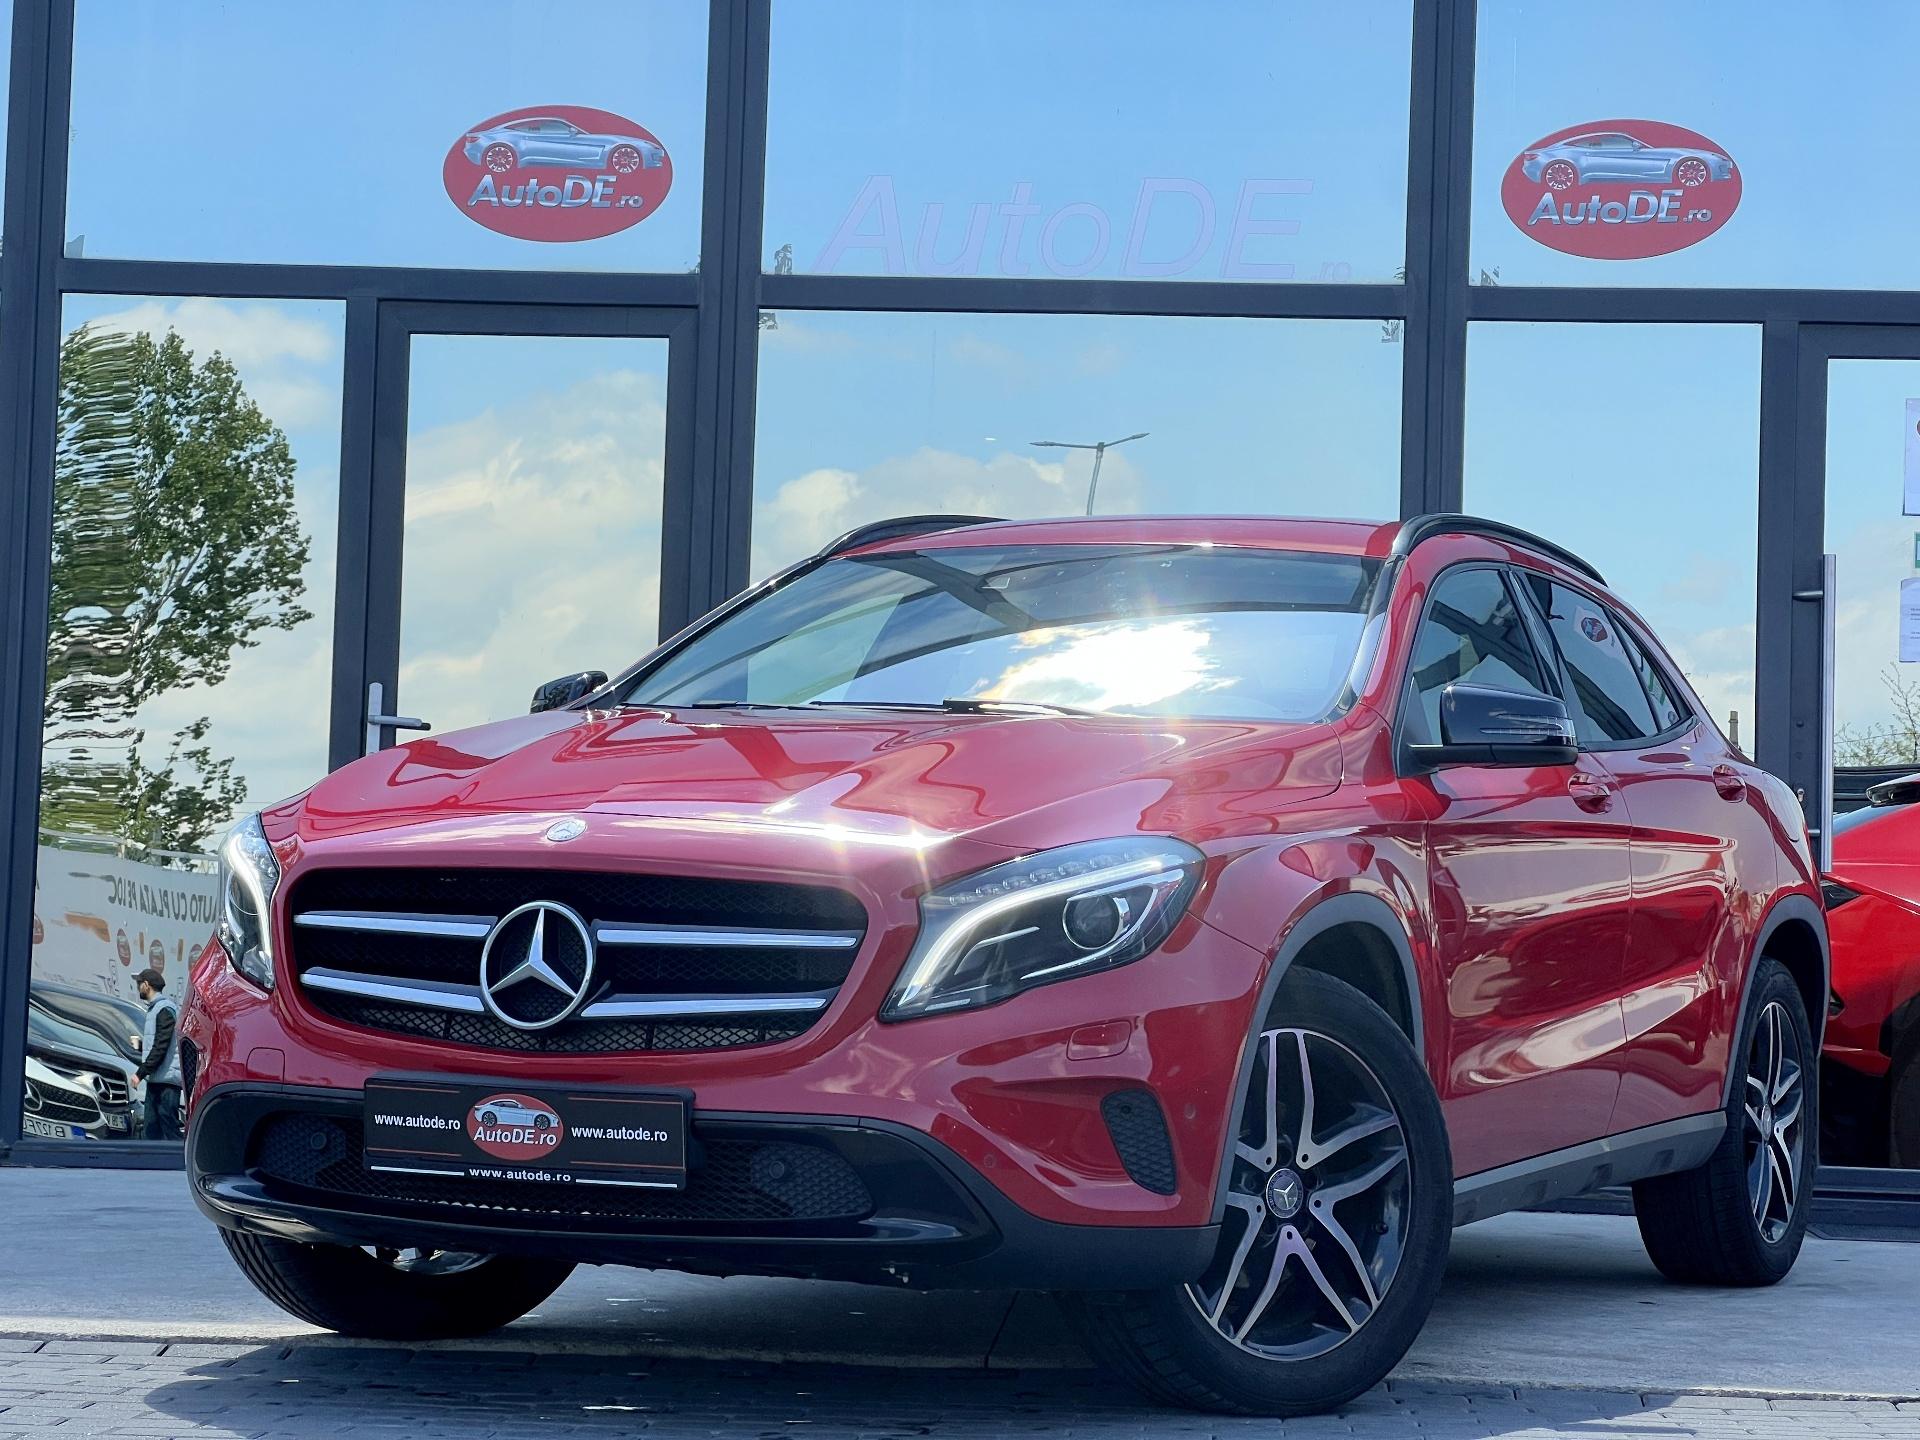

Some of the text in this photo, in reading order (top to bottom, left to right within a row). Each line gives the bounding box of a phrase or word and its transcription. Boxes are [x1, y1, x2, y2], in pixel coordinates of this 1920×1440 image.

[374, 1112, 461, 1131] www.autode.ro
[473, 1126, 557, 1147] AutoDE.ro
[571, 1126, 668, 1143] www.autode.ro
[469, 1167, 571, 1183] www.autode.ro
